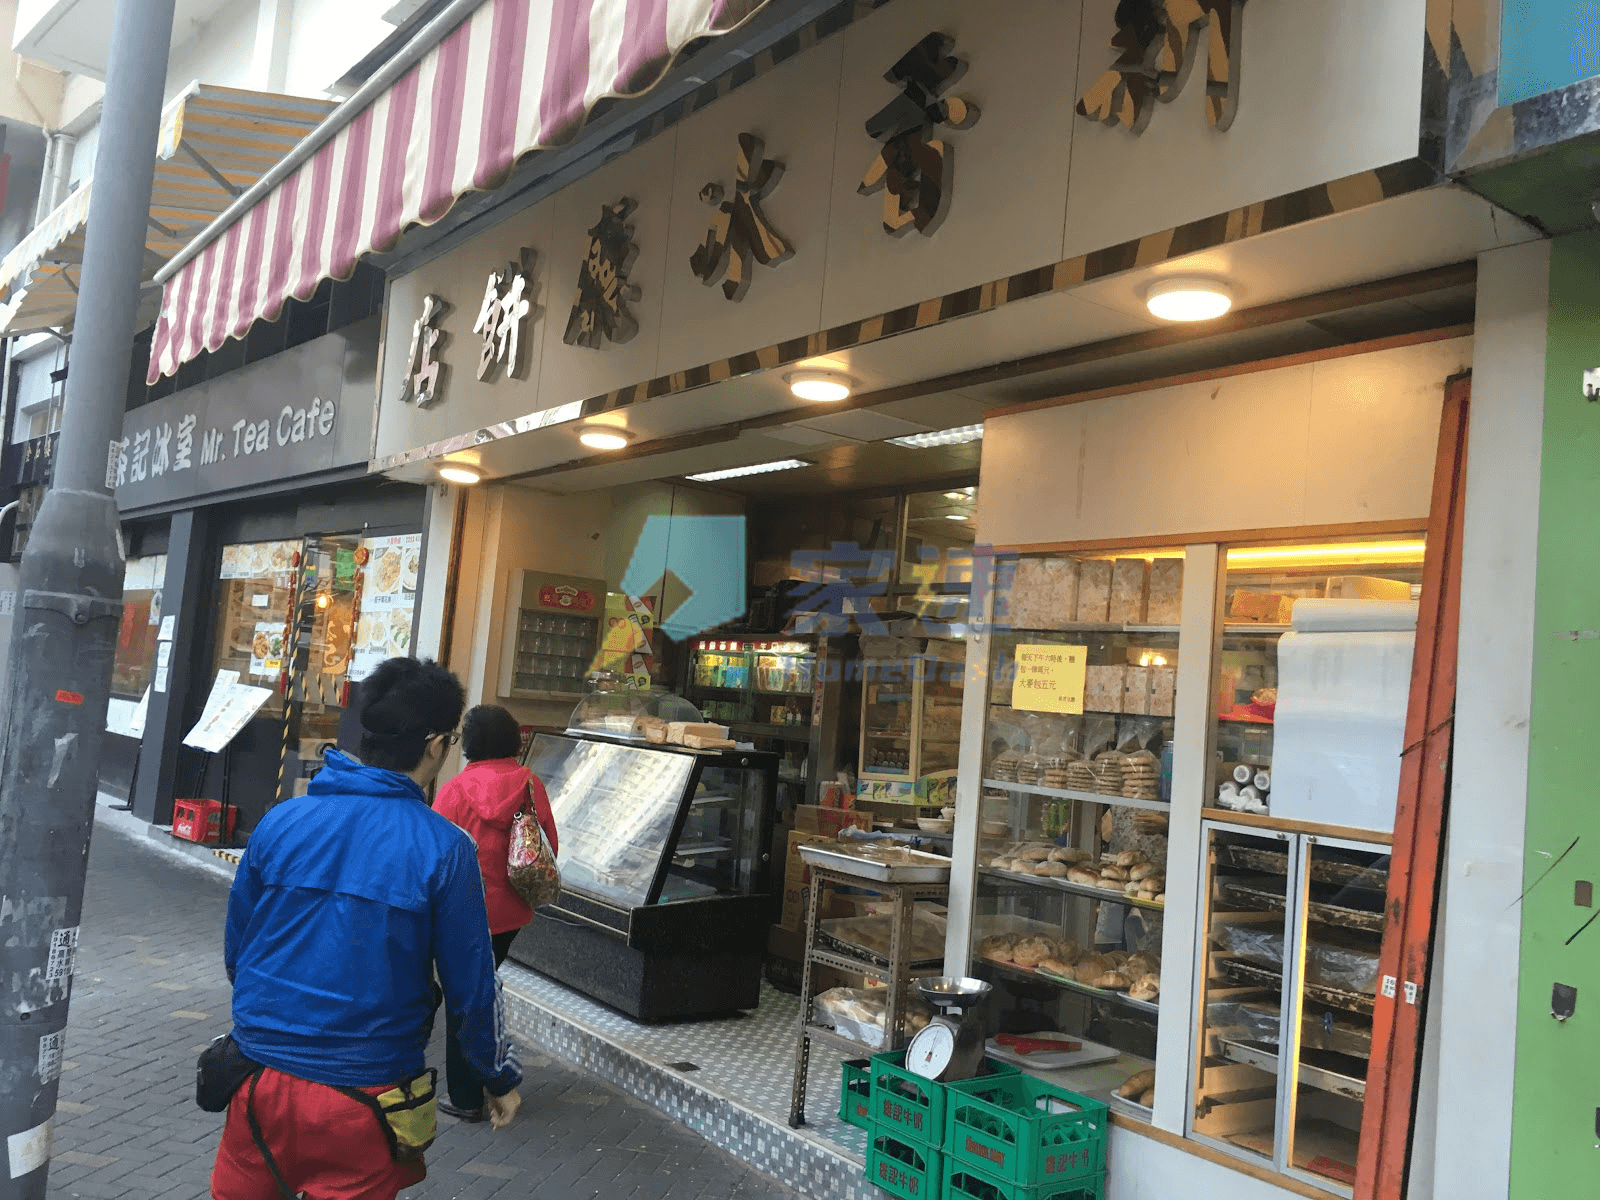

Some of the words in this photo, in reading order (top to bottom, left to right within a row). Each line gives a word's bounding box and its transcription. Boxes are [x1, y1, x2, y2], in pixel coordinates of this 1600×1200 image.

[200, 428, 226, 466] Mr.
[232, 418, 270, 458] Tea
[276, 396, 336, 447] Cafe
